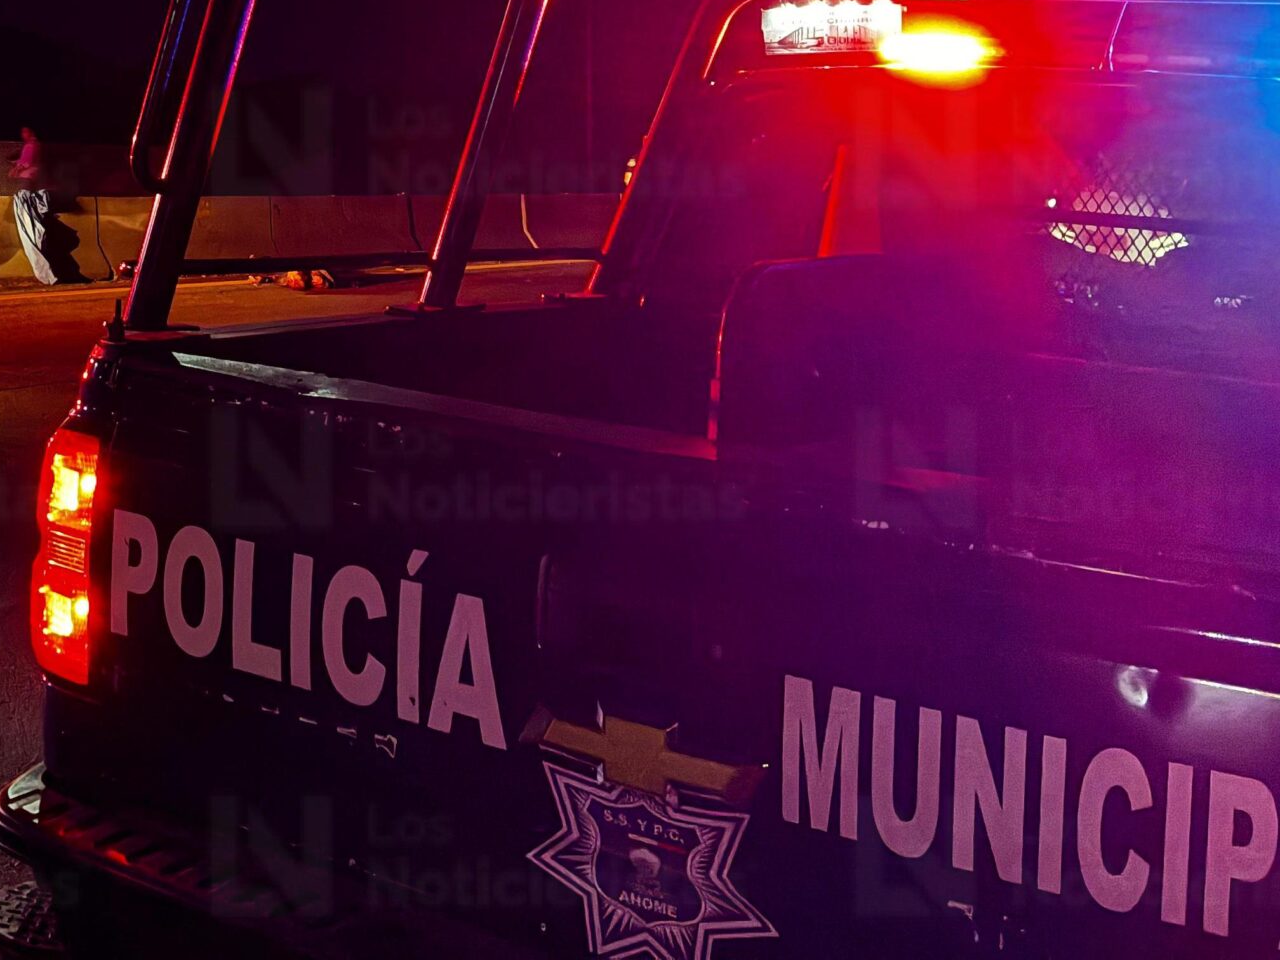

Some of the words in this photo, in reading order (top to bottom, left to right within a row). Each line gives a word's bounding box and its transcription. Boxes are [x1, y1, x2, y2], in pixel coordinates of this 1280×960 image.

[110, 508, 508, 751] POLICÍA
[618, 889, 678, 919] AHOME
[781, 673, 1279, 938] MUNICIP
